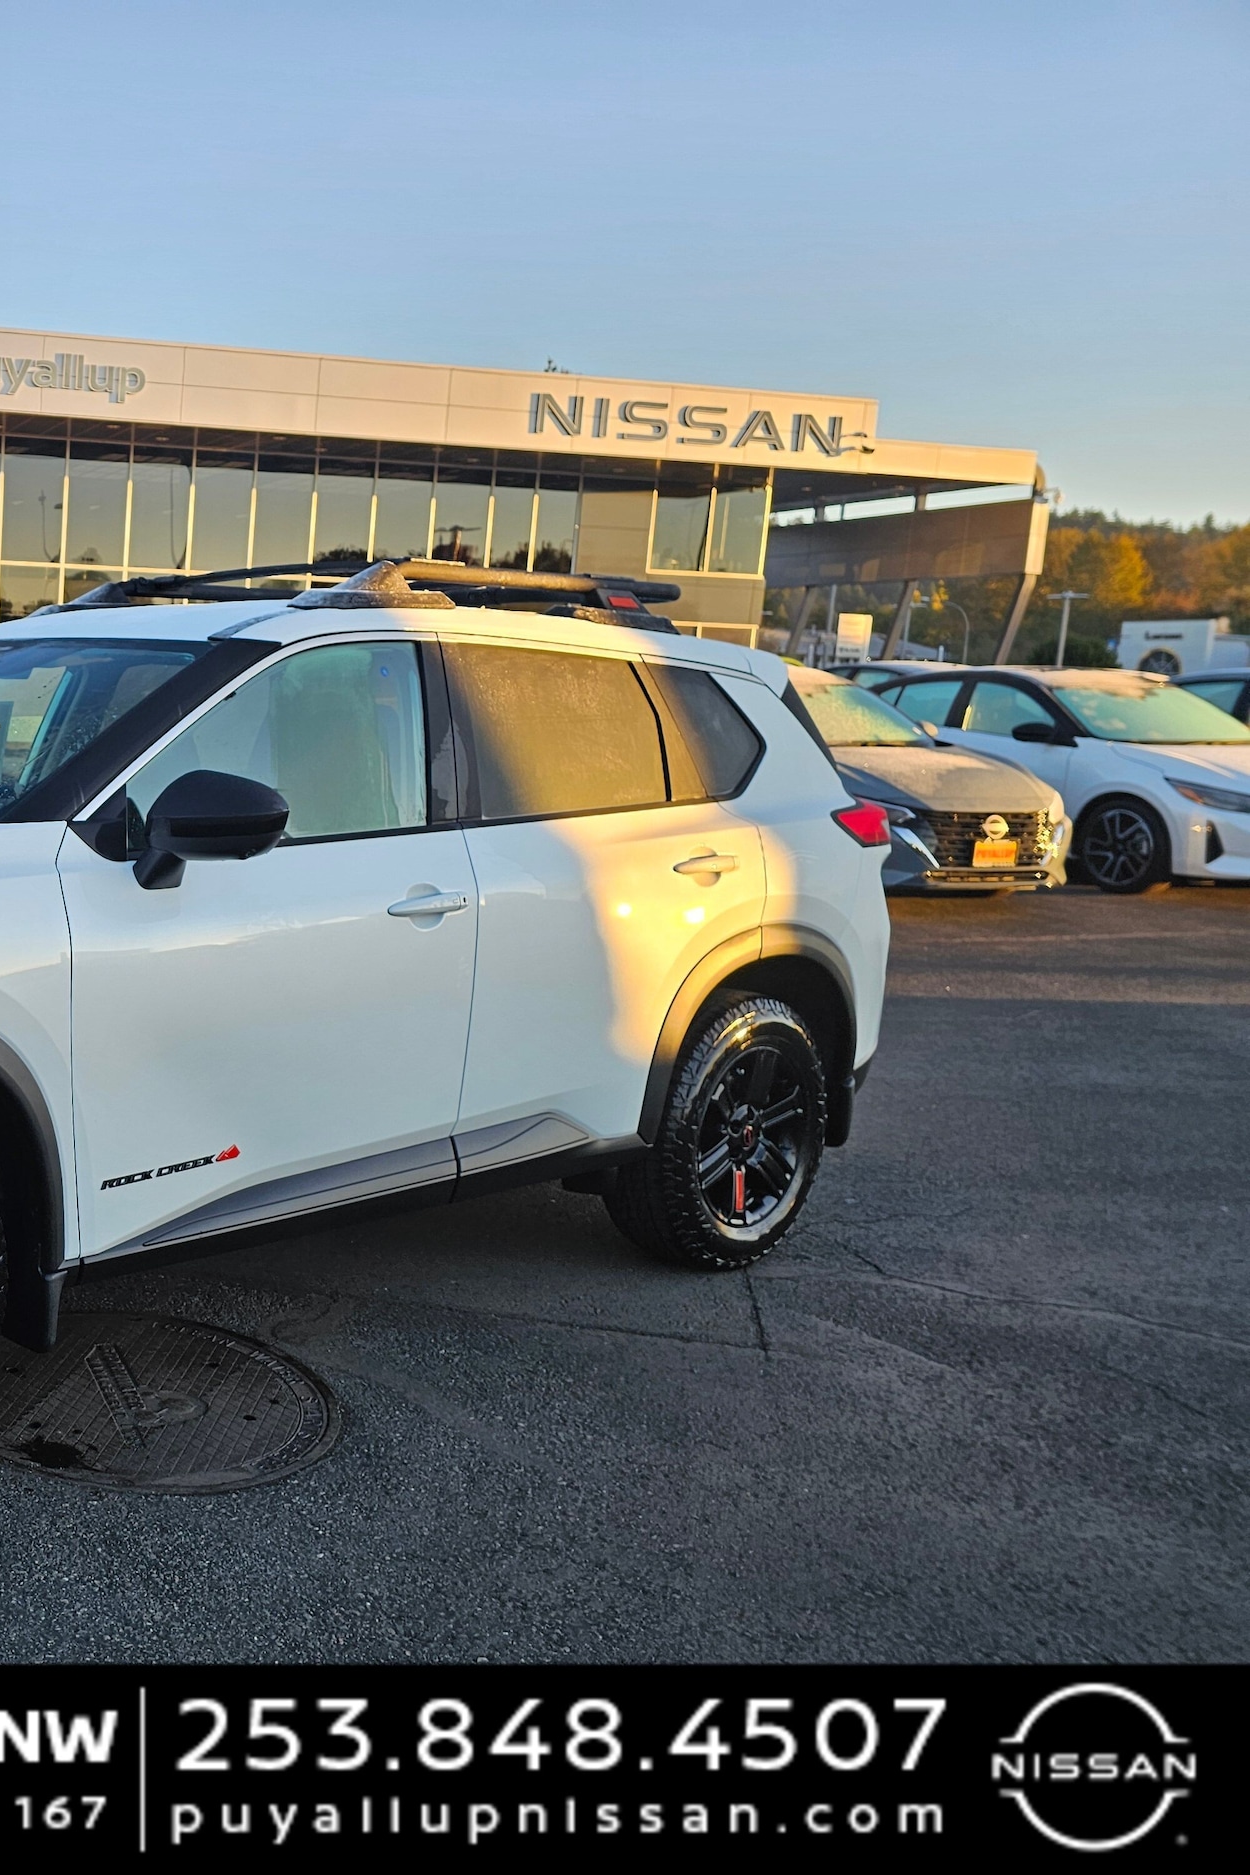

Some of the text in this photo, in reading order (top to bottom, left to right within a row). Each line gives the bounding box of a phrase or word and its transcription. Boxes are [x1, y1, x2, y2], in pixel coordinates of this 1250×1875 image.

[531, 393, 843, 457] NISSAN
[100, 1154, 216, 1191] ROCK CREEK
